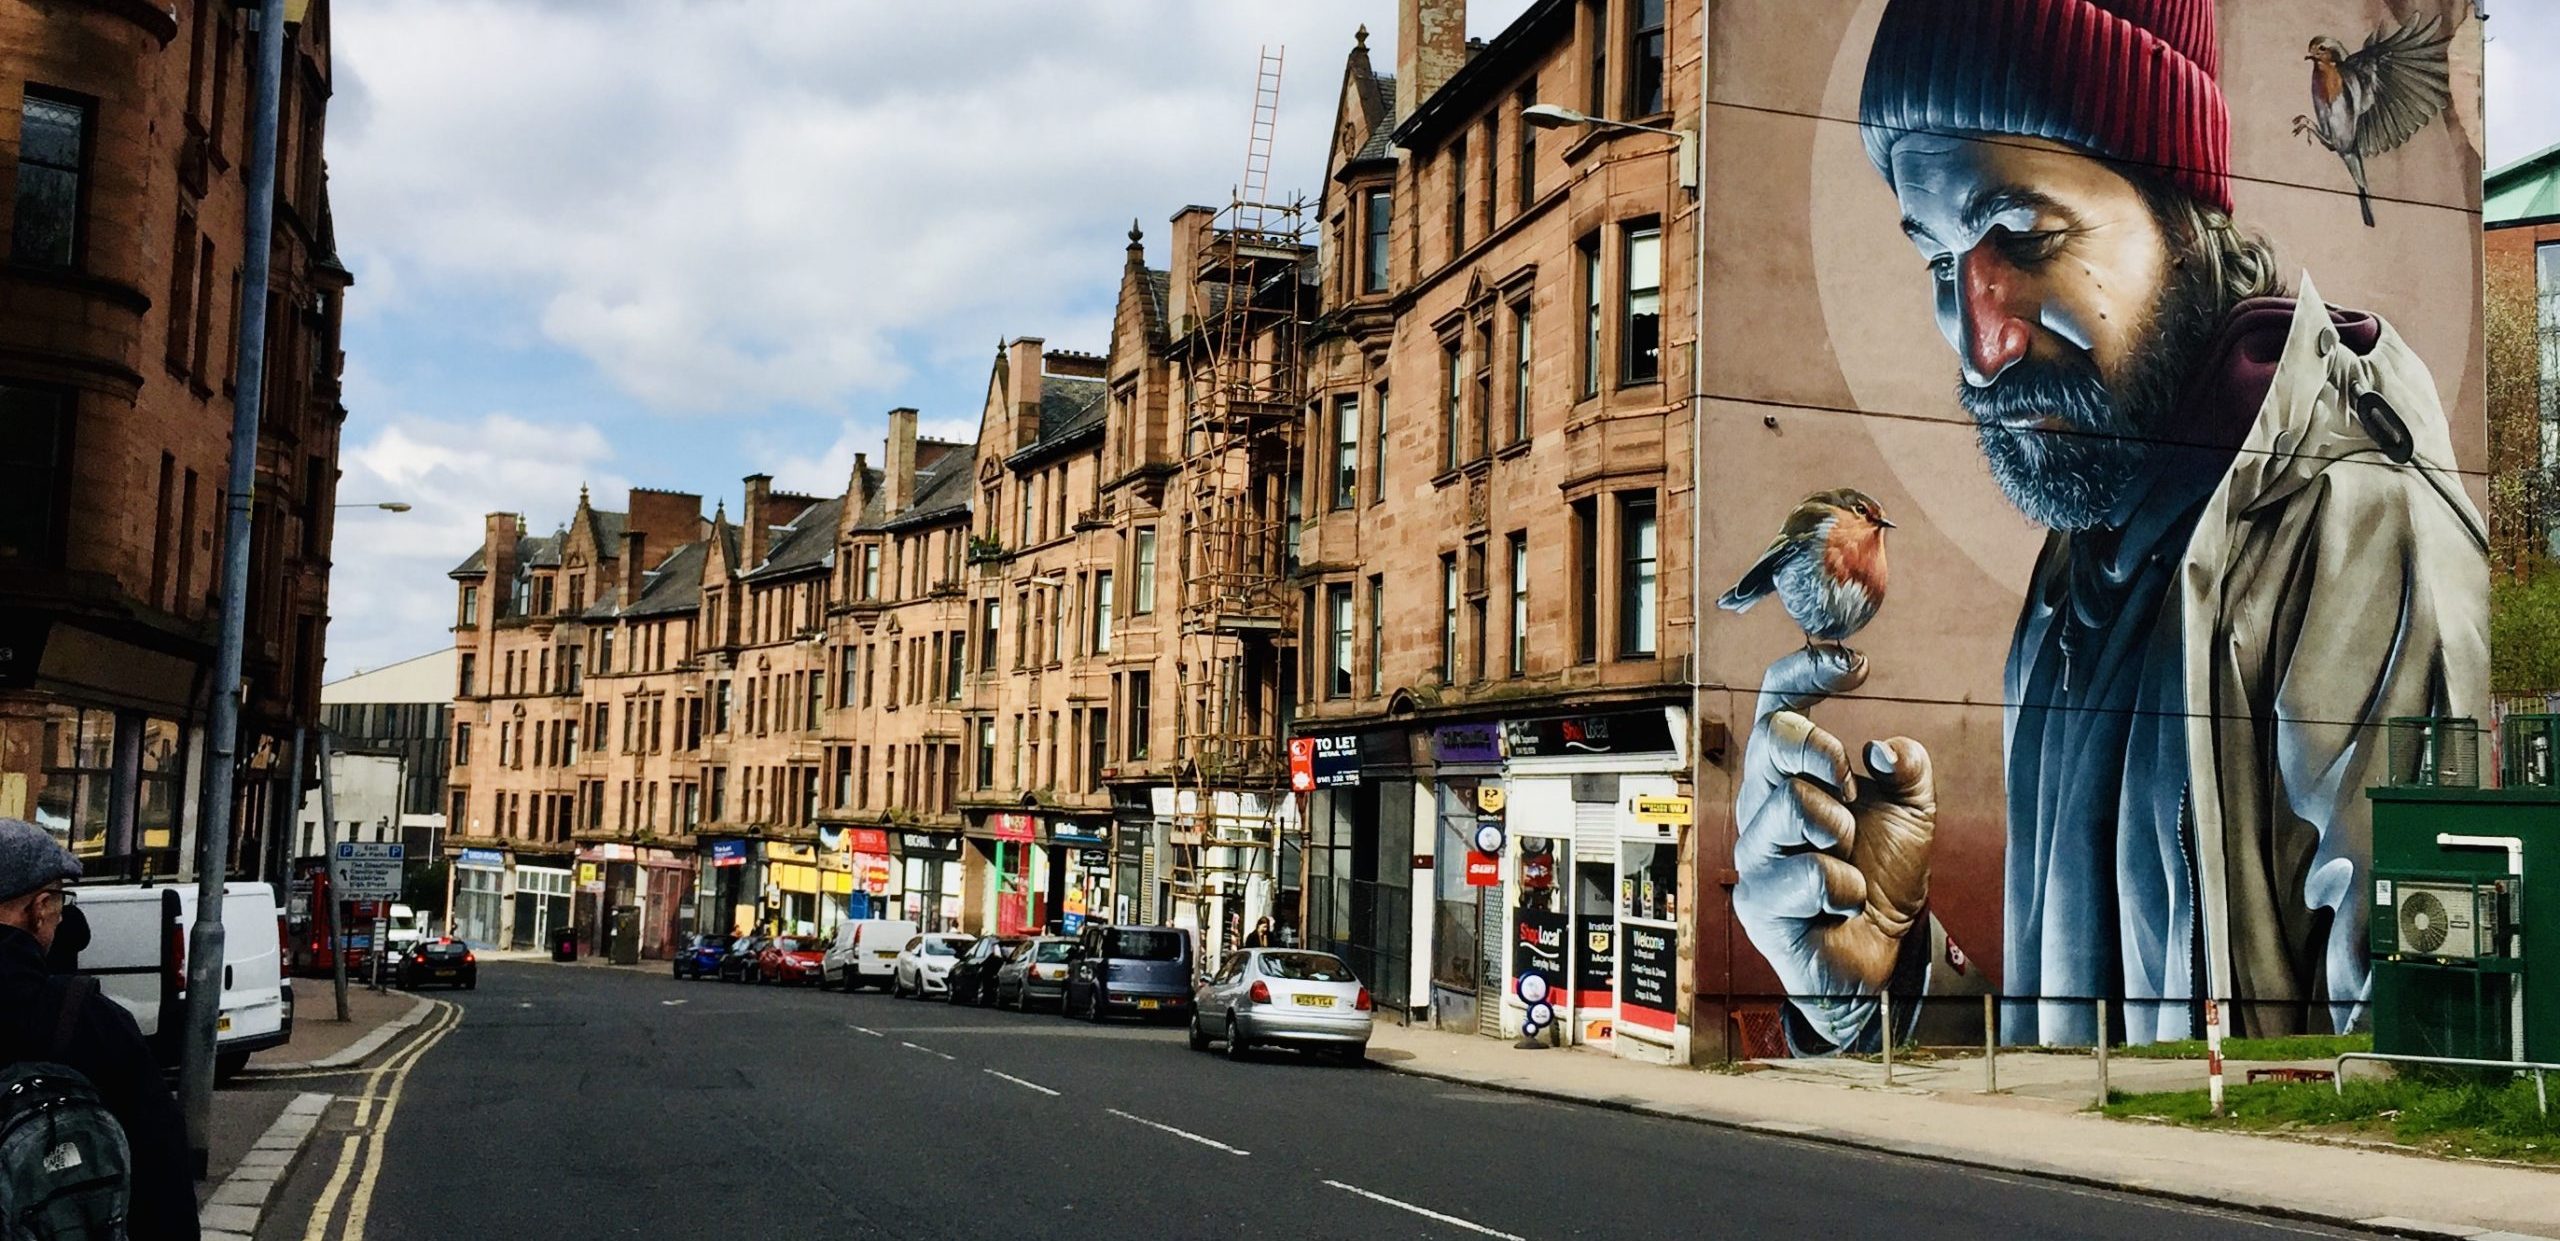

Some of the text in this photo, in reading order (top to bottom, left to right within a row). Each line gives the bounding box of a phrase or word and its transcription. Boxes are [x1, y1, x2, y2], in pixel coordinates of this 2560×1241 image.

[1315, 736, 1356, 750] TO LET
[1633, 930, 1665, 951] Welcome
